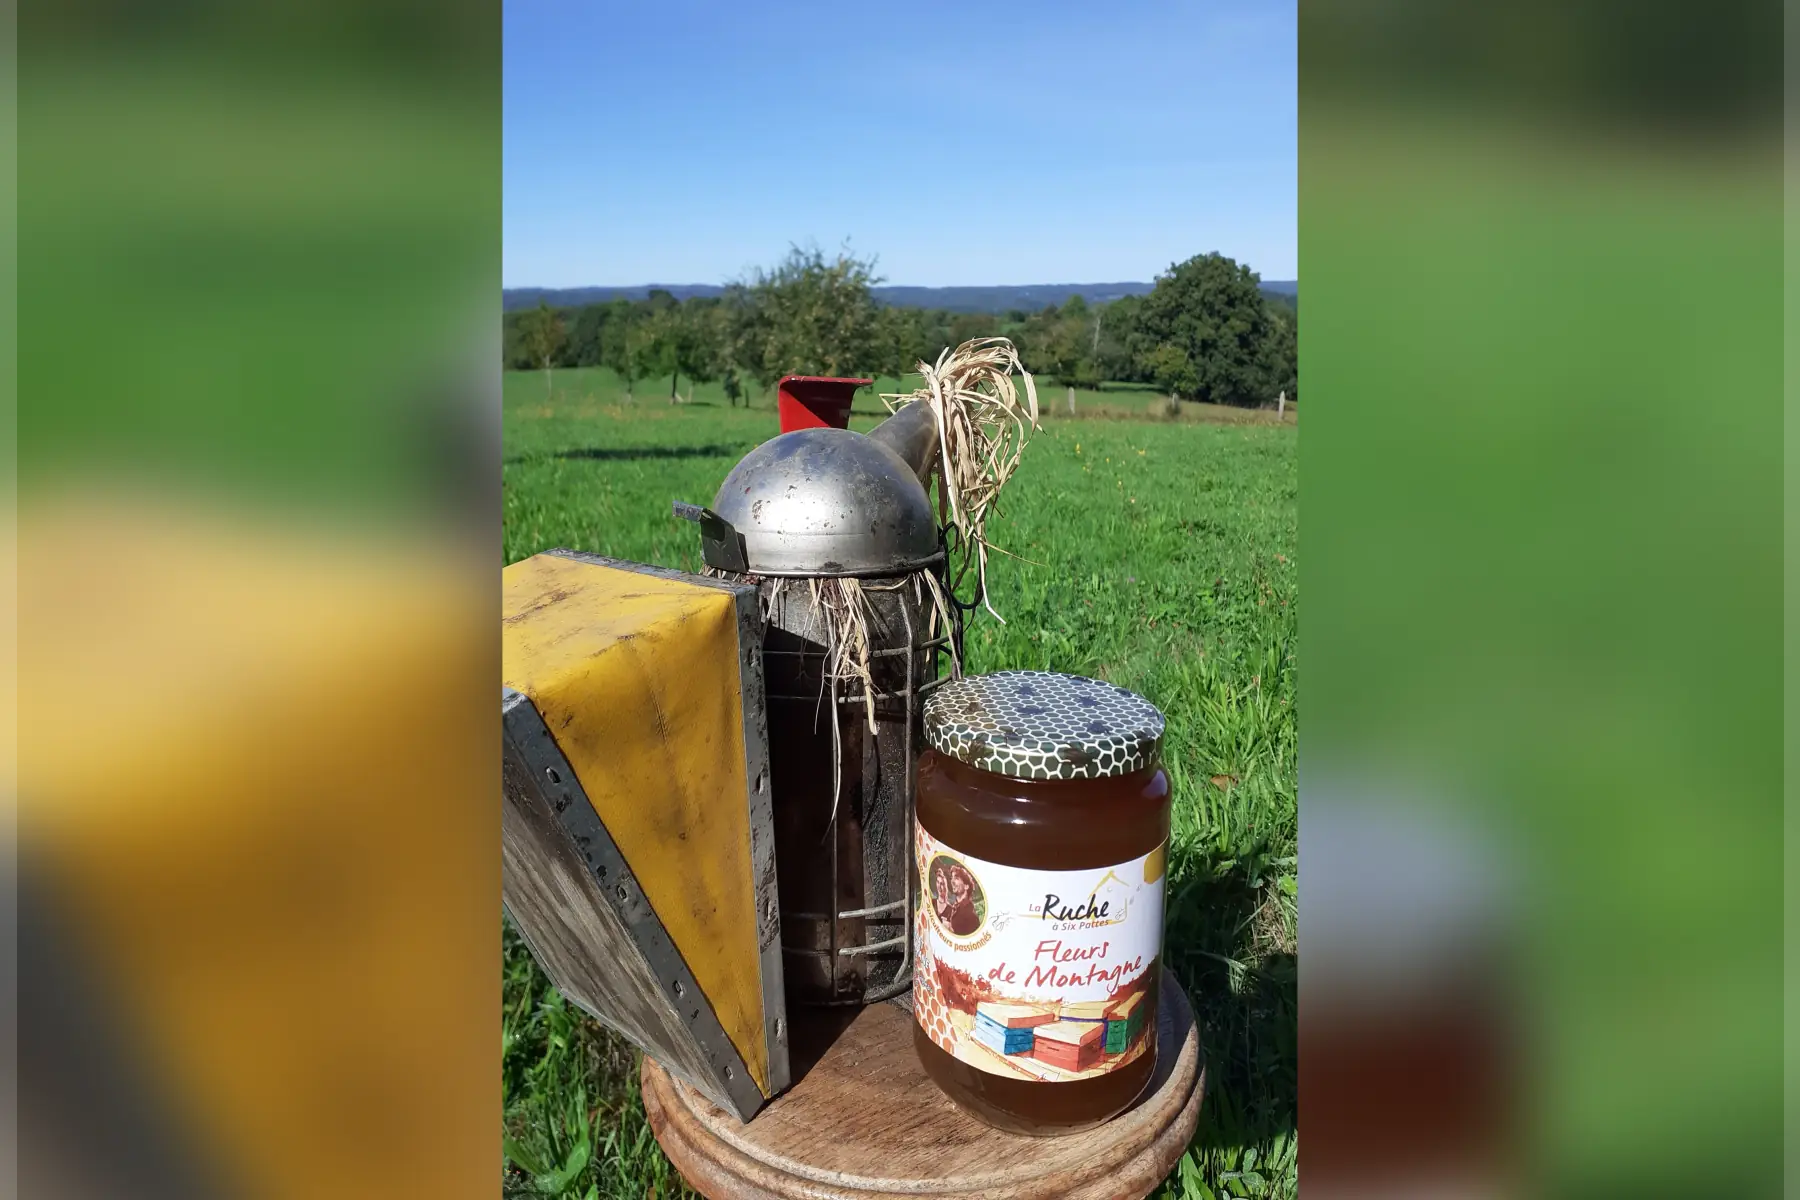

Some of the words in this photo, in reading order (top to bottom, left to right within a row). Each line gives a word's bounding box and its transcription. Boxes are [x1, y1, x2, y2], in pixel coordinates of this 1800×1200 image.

[1028, 903, 1041, 912] La
[1042, 894, 1110, 921] Ruche
[1052, 922, 1059, 931] à
[1061, 921, 1076, 931] Six
[1079, 919, 1109, 930] Pattes
[953, 931, 992, 952] passionnés
[1035, 939, 1109, 963] Fleurs
[988, 962, 1016, 984] de
[1024, 956, 1142, 993] Montagne
